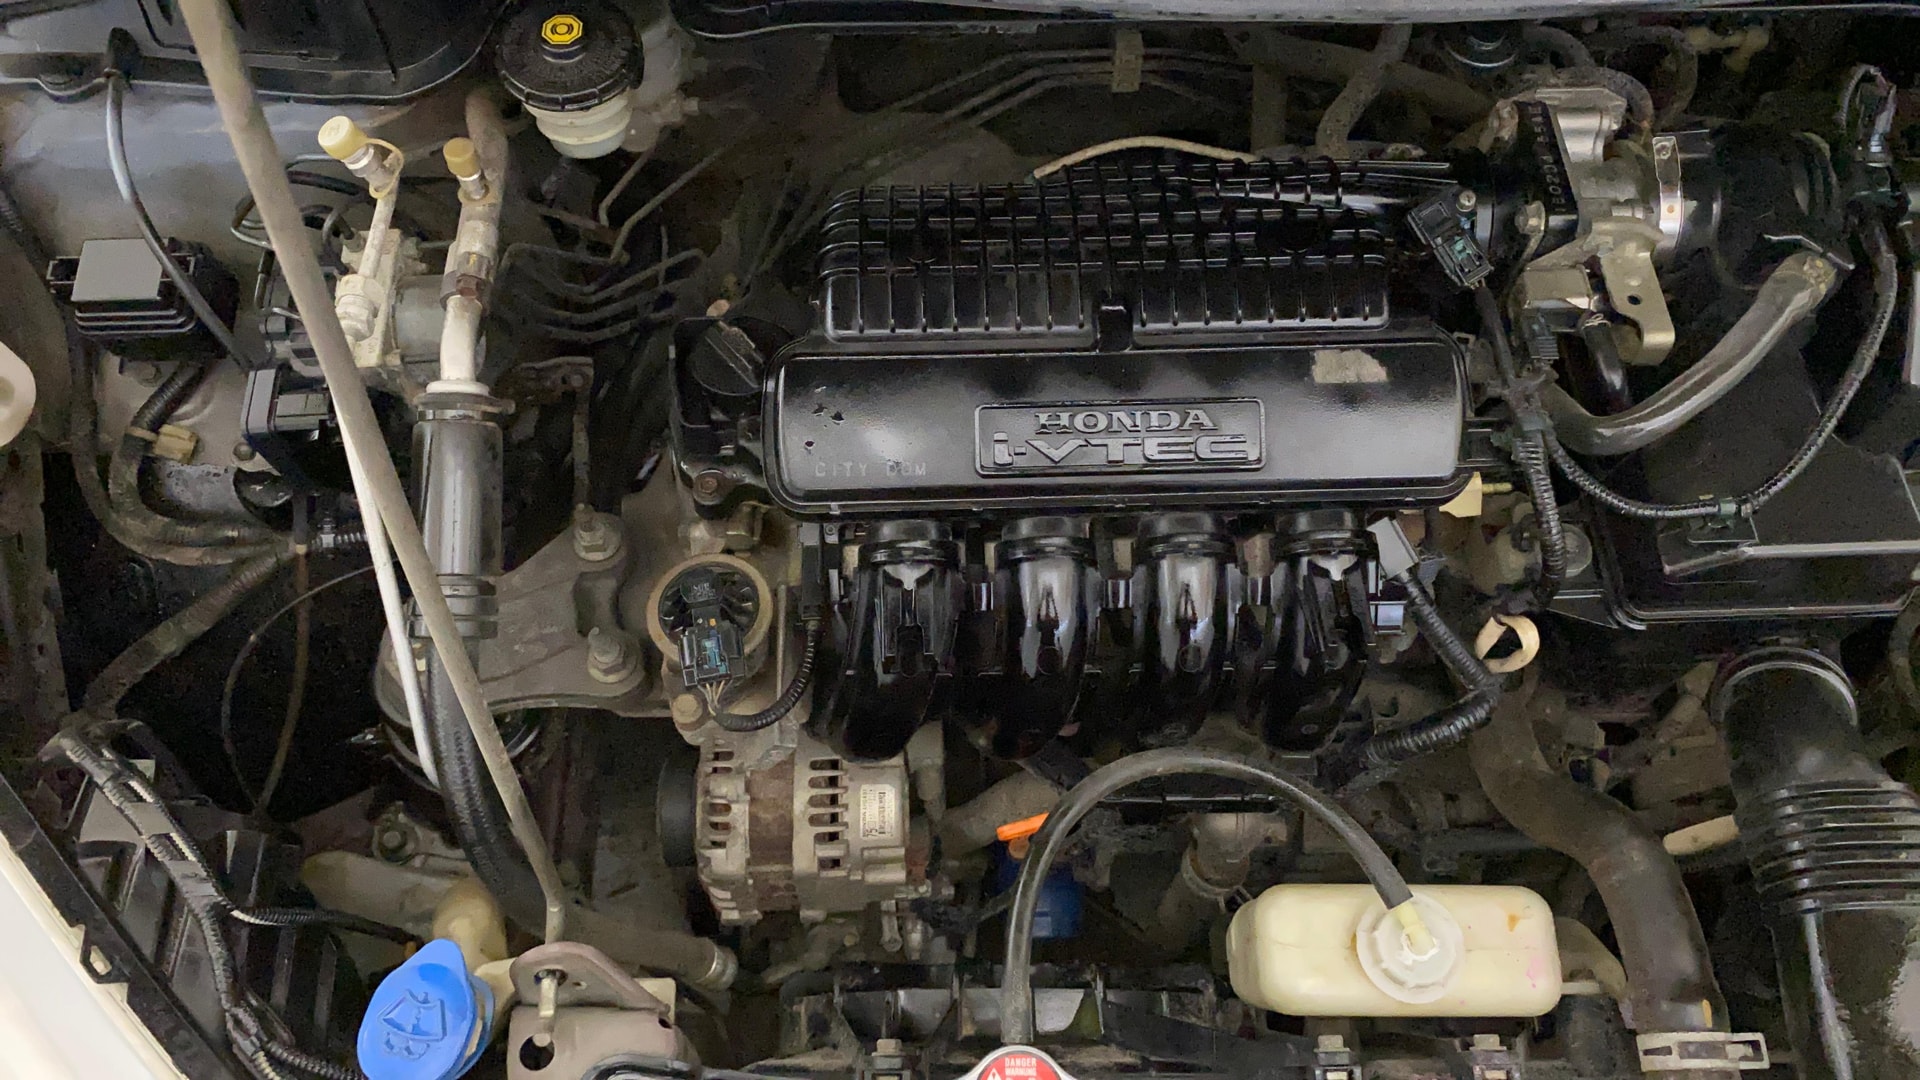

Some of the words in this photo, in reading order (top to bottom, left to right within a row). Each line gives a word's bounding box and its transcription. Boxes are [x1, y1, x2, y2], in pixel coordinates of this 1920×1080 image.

[1034, 408, 1218, 434] HONDA
[992, 430, 1248, 467] i-VTEC
[814, 460, 868, 477] CITY
[885, 460, 927, 477] DOM
[1005, 1057, 1037, 1067] DANGER
[1005, 1067, 1037, 1076] WARNING
